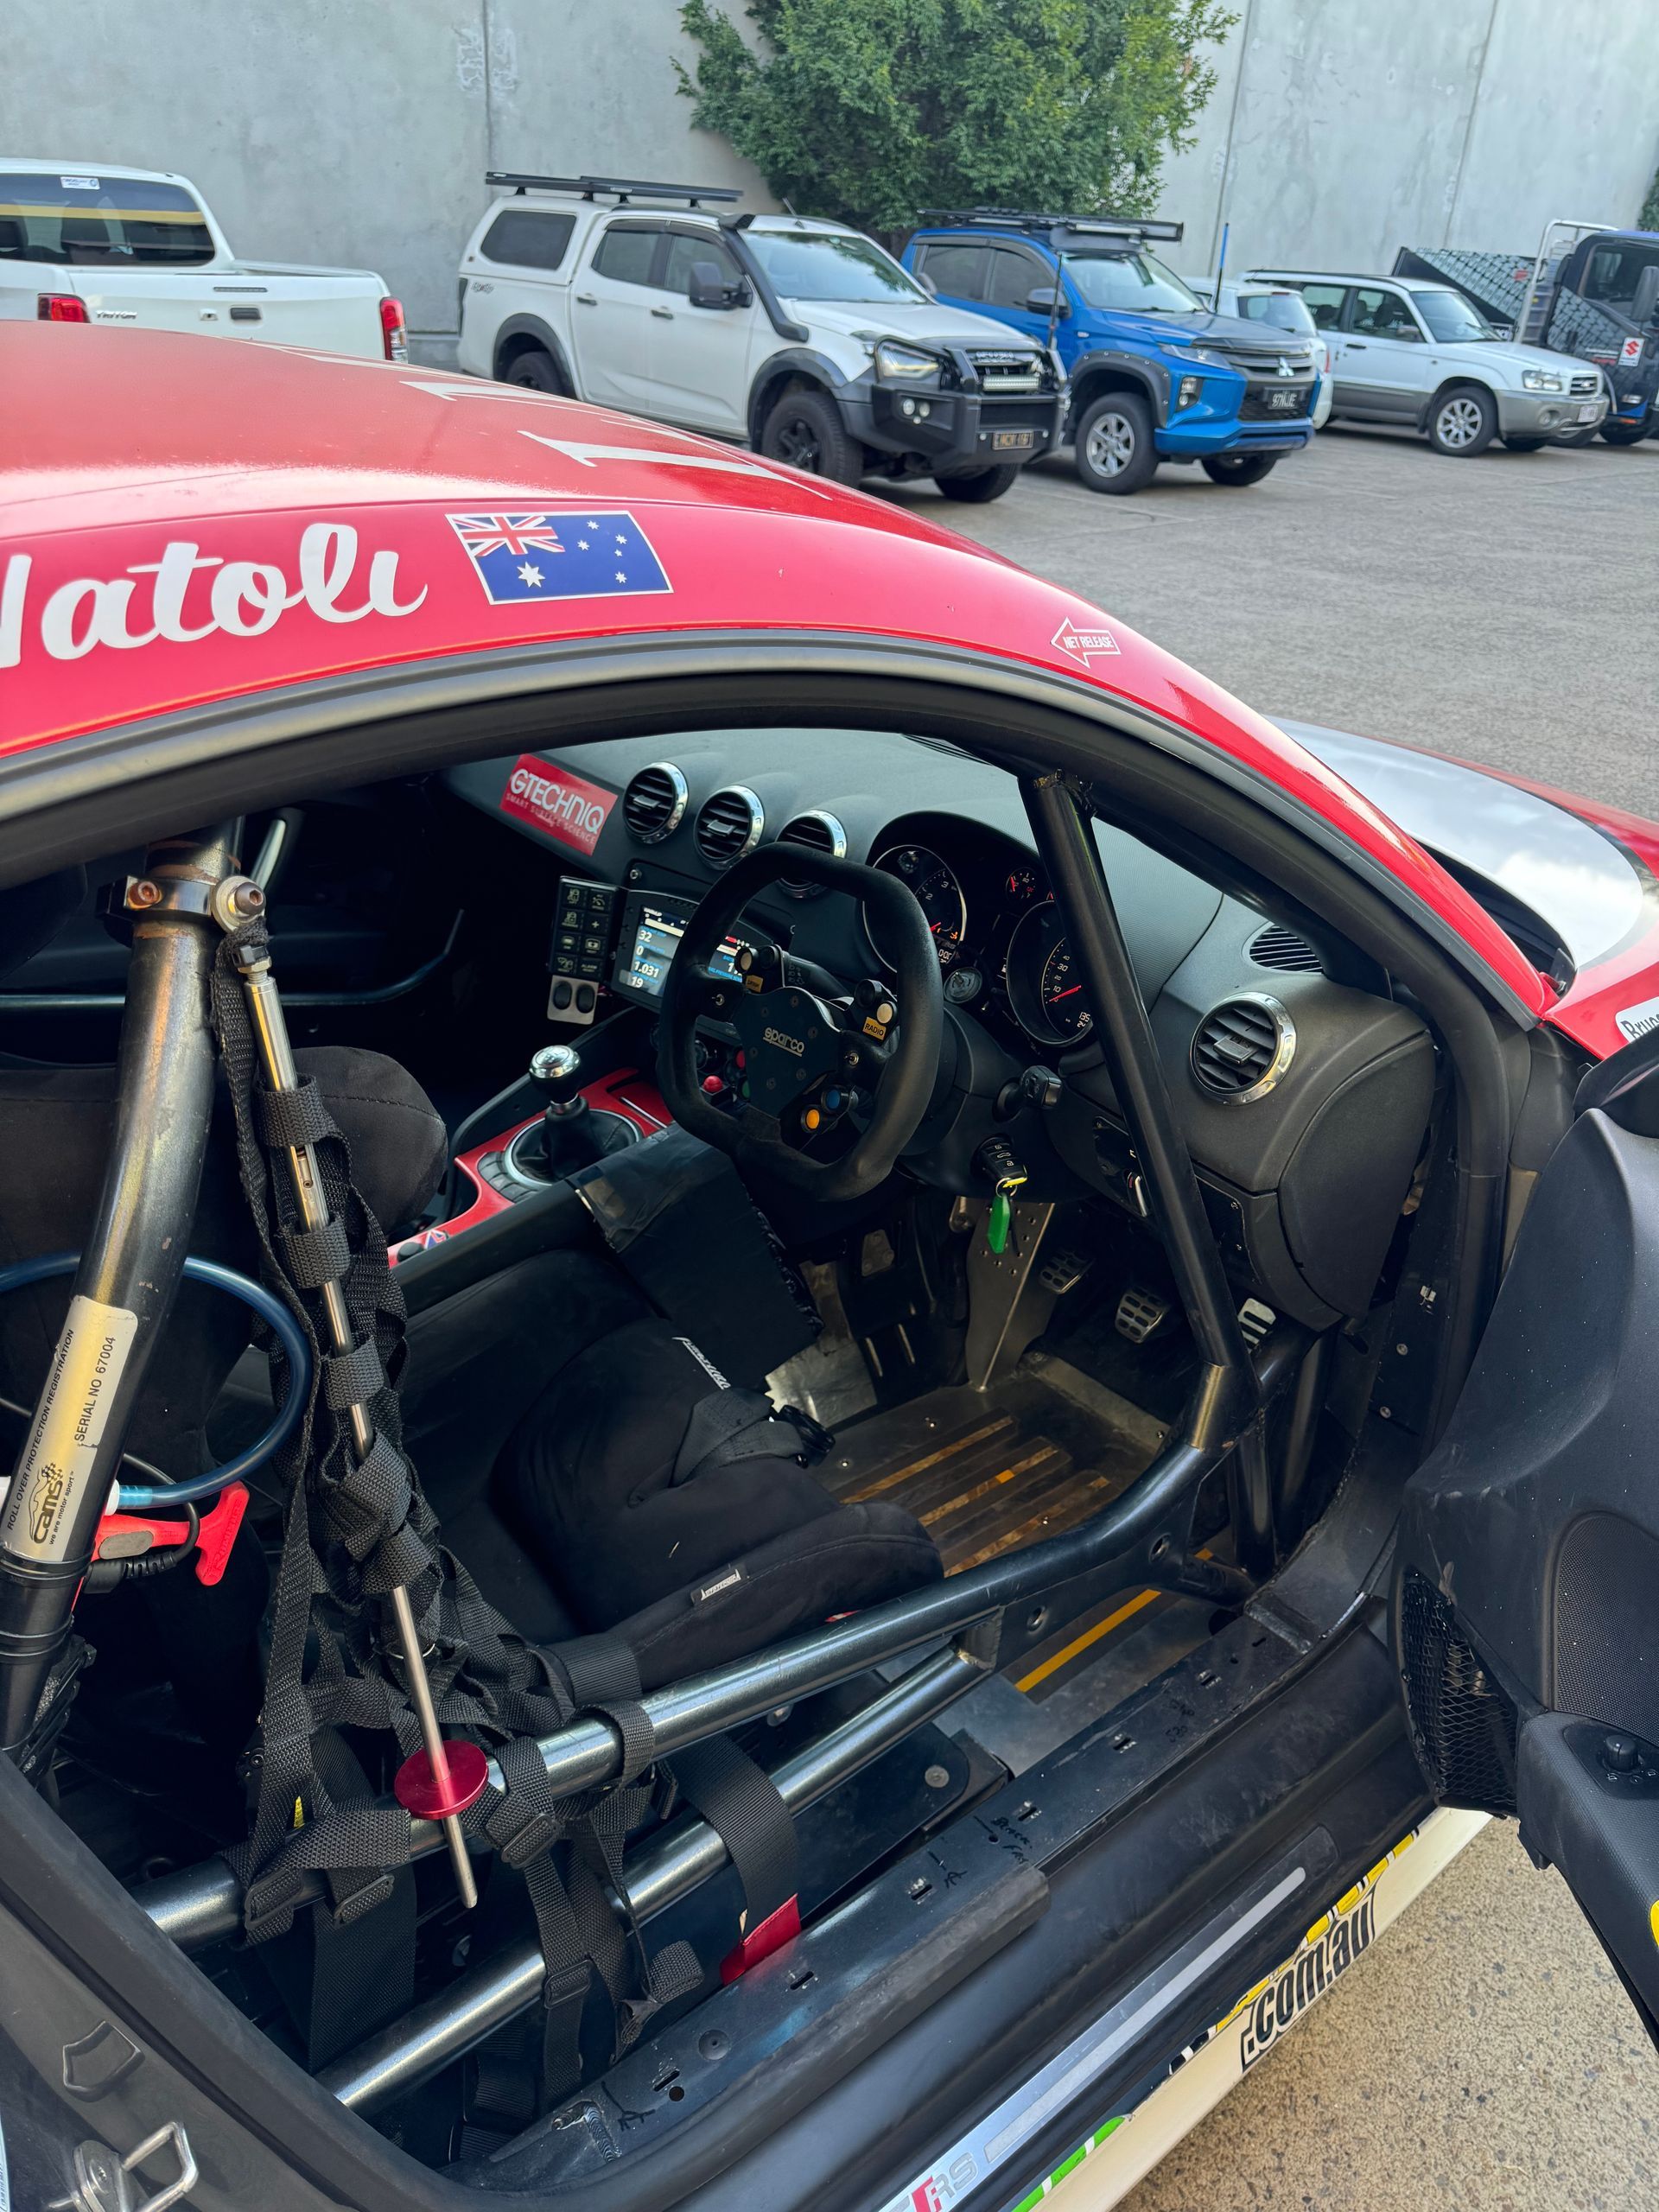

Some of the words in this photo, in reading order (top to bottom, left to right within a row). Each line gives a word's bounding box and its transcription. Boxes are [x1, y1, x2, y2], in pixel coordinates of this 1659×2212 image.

[1062, 635, 1081, 649] NET
[1078, 635, 1115, 649] RELEASE
[510, 768, 605, 835] GTECHNIQ
[505, 792, 529, 810] SMART
[563, 821, 596, 844] SCIENCE
[638, 929, 652, 943] 32
[635, 945, 645, 956] 0
[633, 961, 659, 978] 1.031
[1056, 963, 1069, 972] 30
[631, 976, 644, 988] 19
[1052, 985, 1062, 994] 10
[865, 1023, 884, 1037] RADIO
[764, 1027, 805, 1053] sparco
[73, 1399, 97, 1442] SERIAL
[88, 1378, 102, 1397] NO
[95, 1337, 116, 1374] 67004
[7, 1503, 21, 1530] ROLL
[16, 1472, 30, 1502] OVER
[25, 1406, 51, 1472] PROTECTION
[47, 1329, 74, 1405] REGISTRATION
[48, 1533, 57, 1546] we
[53, 1520, 61, 1534] are
[57, 1497, 68, 1521] motor
[65, 1477, 75, 1497] sport
